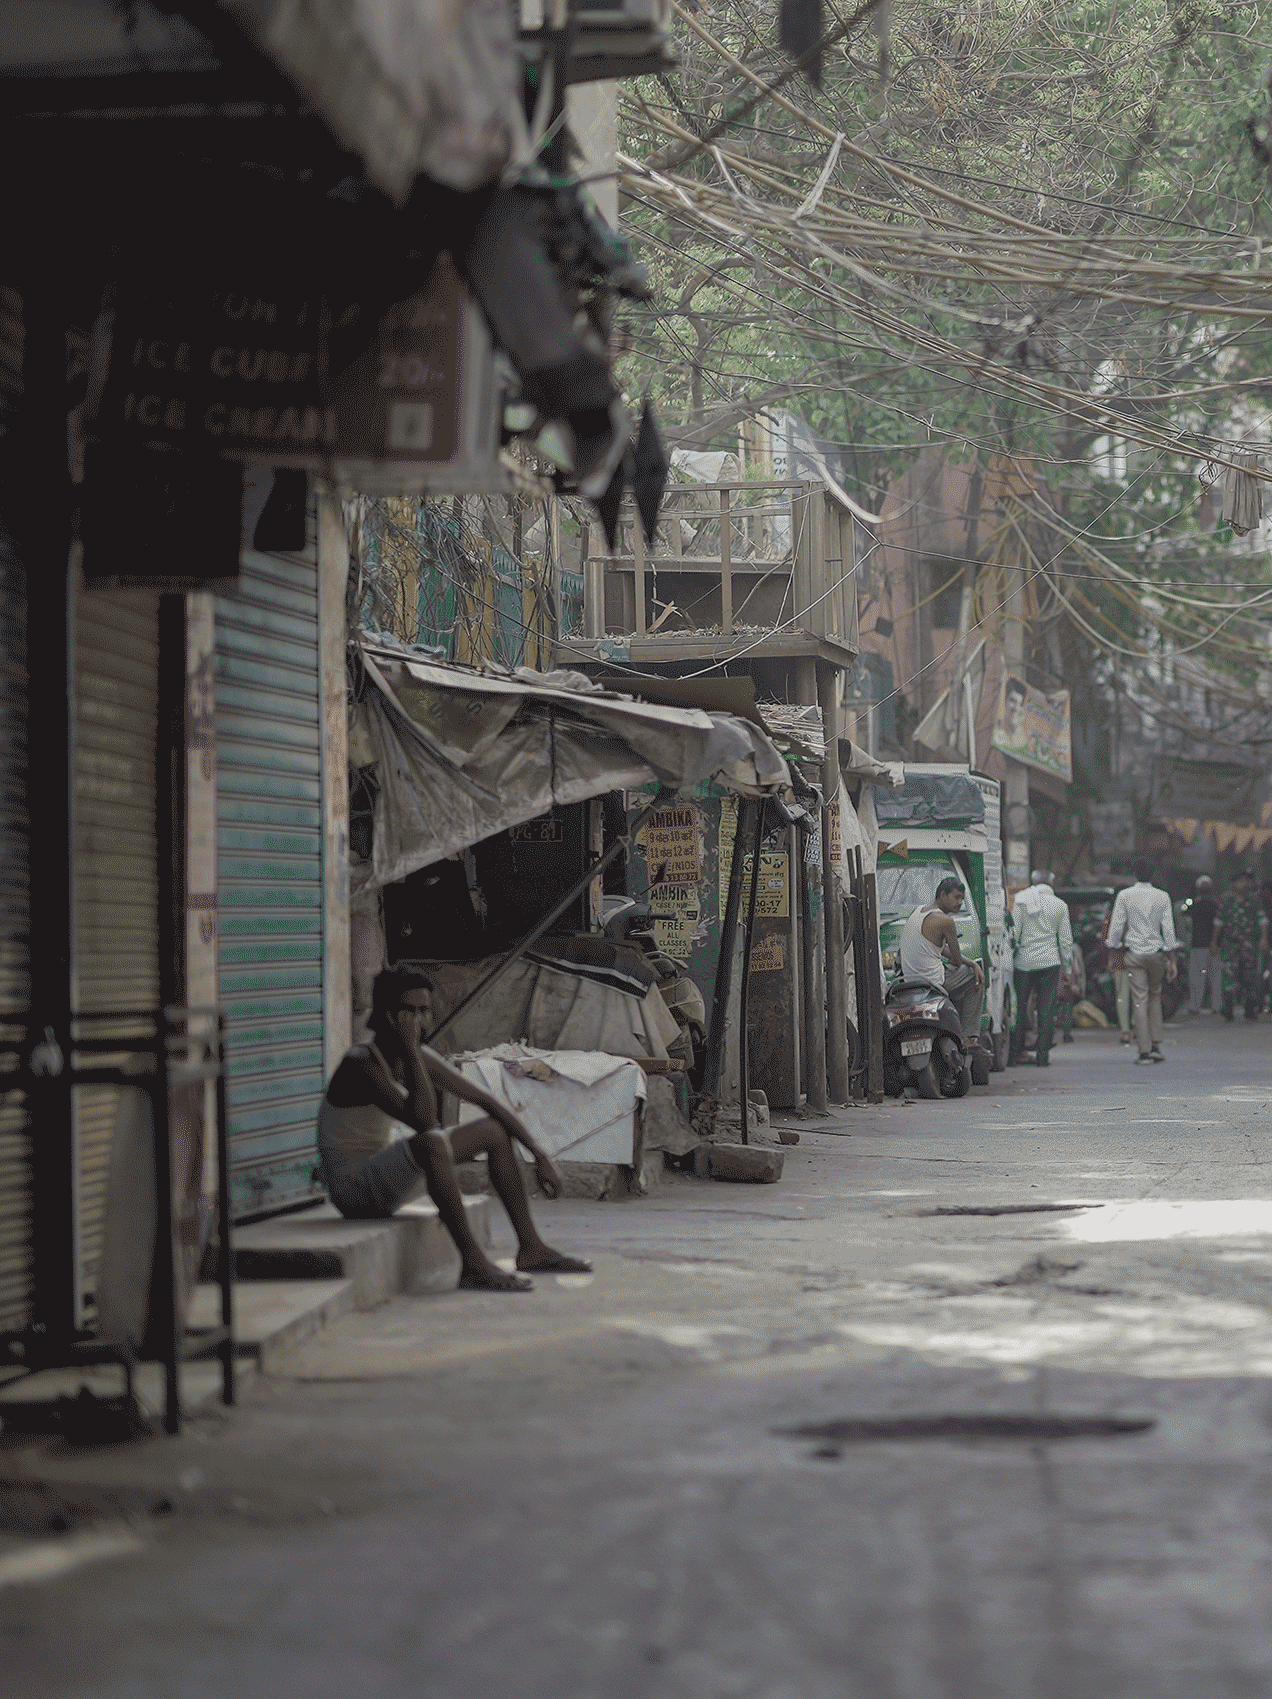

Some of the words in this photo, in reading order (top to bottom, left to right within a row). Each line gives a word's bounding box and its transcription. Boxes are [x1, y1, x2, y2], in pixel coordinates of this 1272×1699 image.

[648, 811, 692, 829] AMBIKA
[670, 831, 680, 842] 10
[650, 847, 659, 858] 11
[673, 845, 683, 857] 12
[662, 921, 685, 931] FREE
[658, 939, 687, 948] CLASSES
